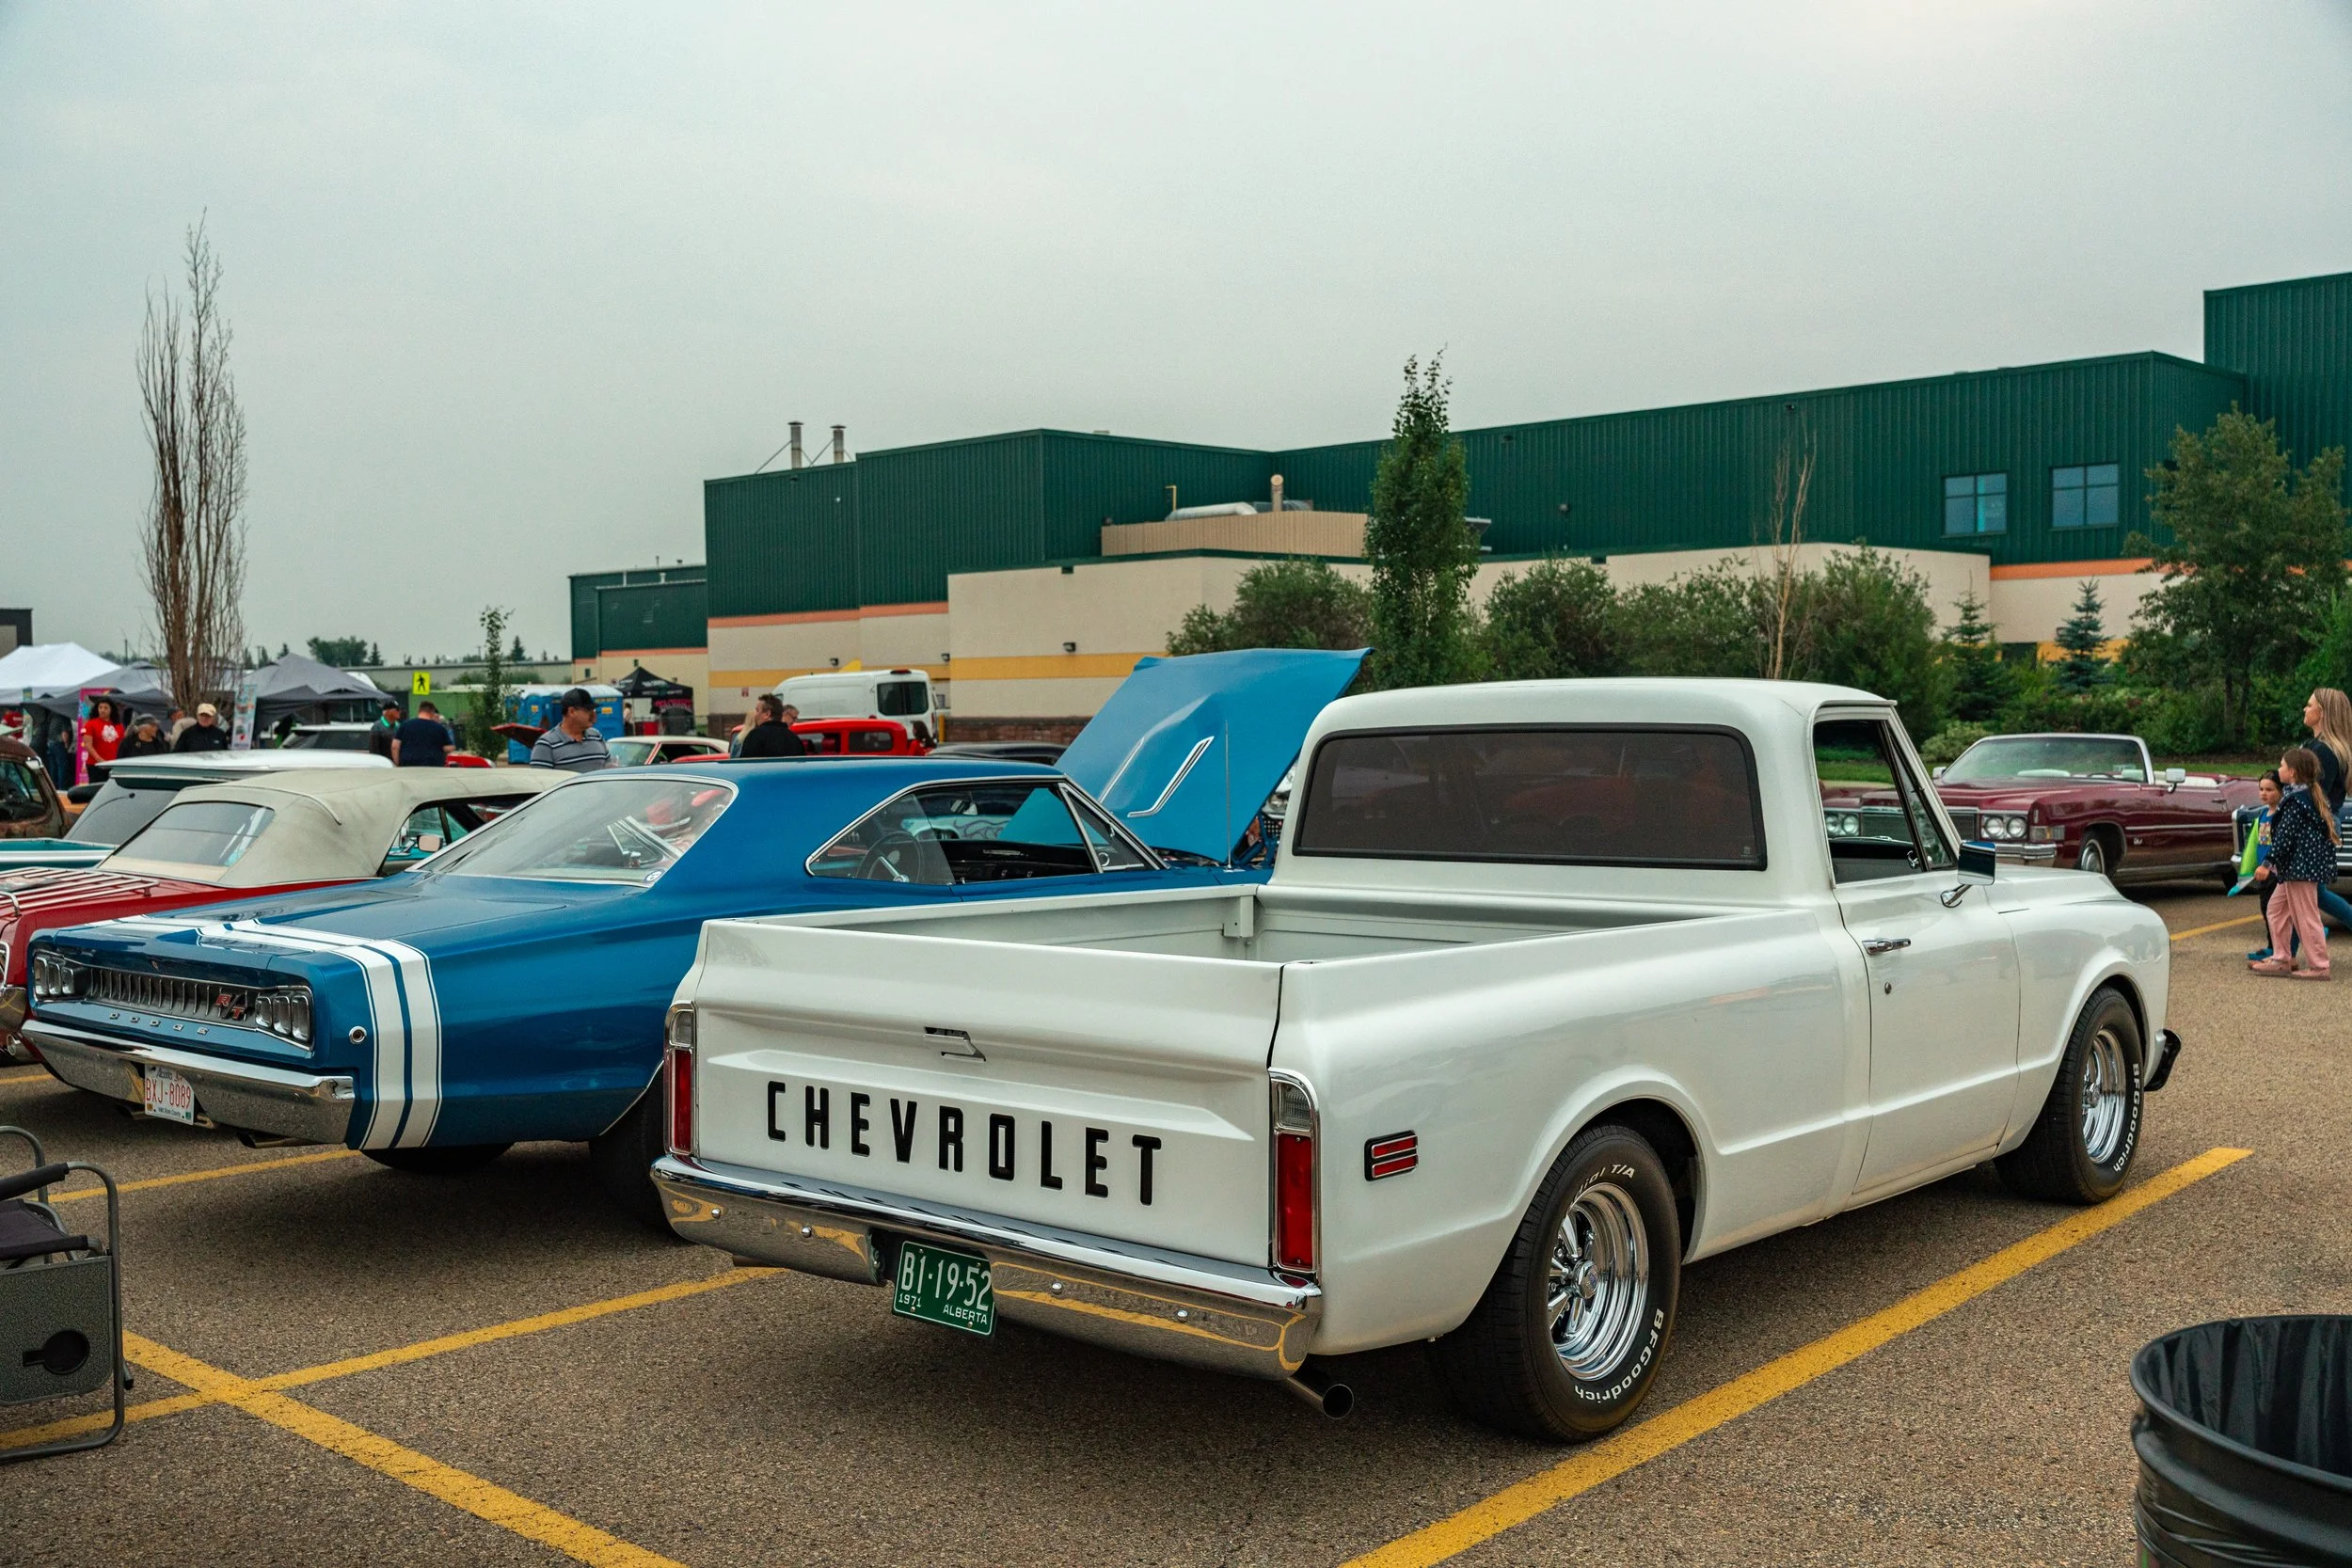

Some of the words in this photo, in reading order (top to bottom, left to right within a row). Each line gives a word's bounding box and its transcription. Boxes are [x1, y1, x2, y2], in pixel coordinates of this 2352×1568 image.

[215, 993, 246, 1021] R/T
[109, 1012, 209, 1036] DODGE
[145, 1077, 192, 1110] BXJ-8089
[2112, 1063, 2141, 1173] BFGoodrich
[767, 1080, 1162, 1206] CHEVROLET
[1610, 1164, 1635, 1179] T/A
[898, 1292, 922, 1308] 1971
[943, 1304, 988, 1325] ALBERTA
[1574, 1308, 1664, 1403] BFGoodrich
